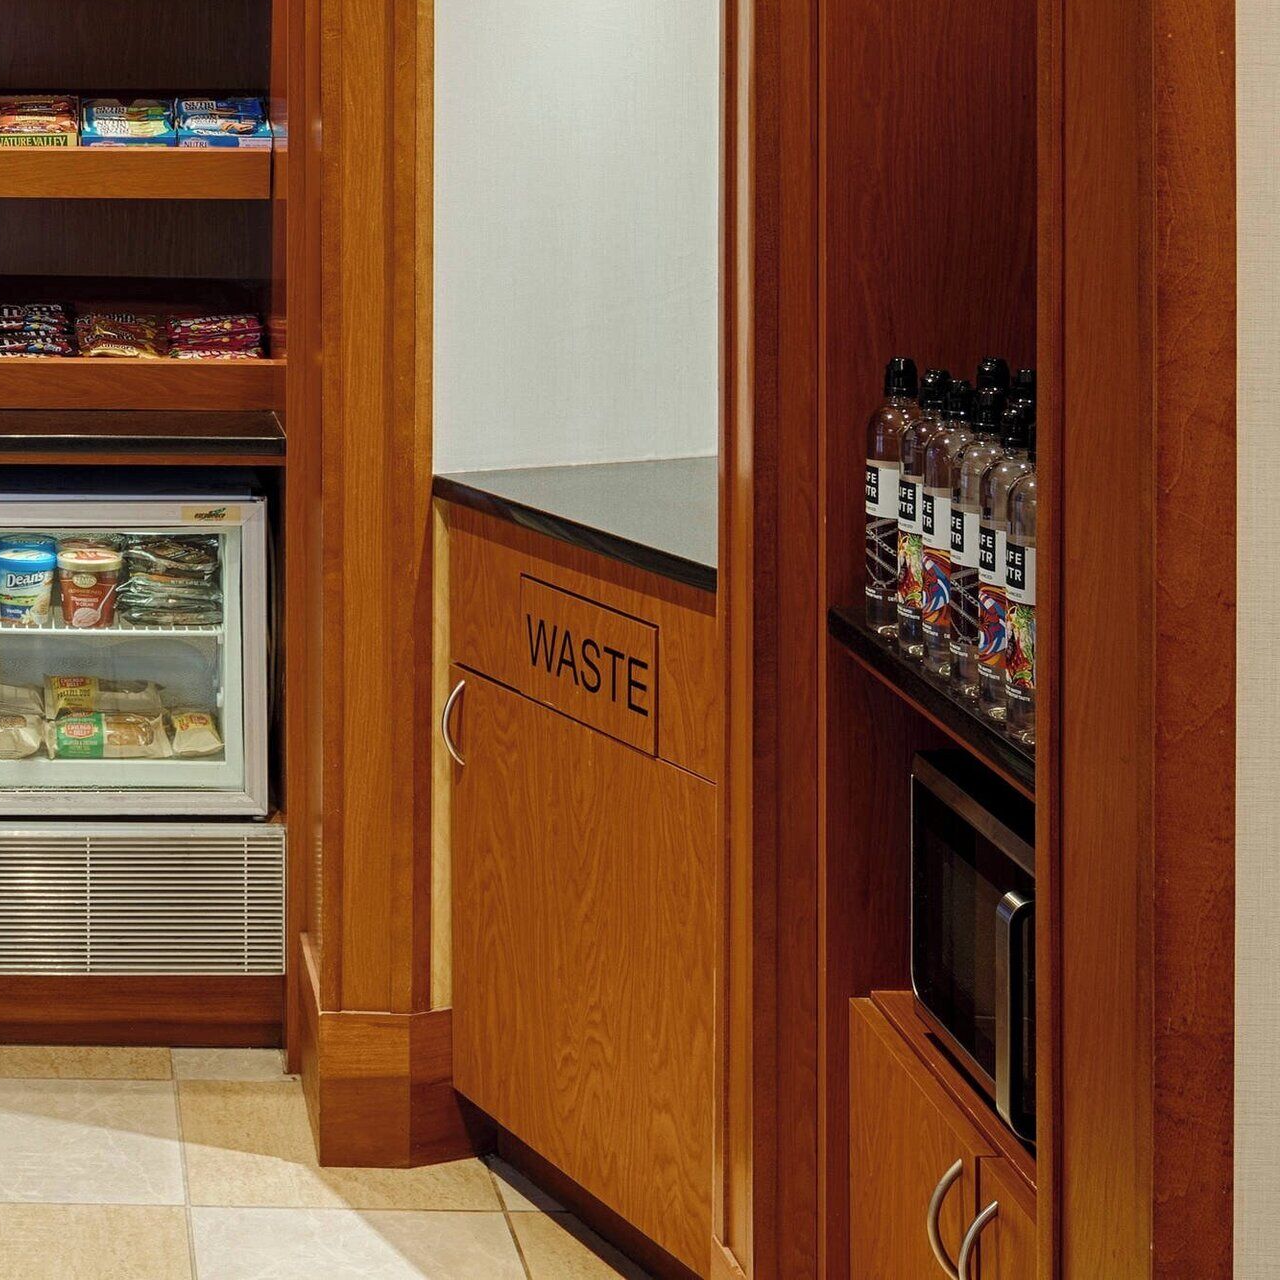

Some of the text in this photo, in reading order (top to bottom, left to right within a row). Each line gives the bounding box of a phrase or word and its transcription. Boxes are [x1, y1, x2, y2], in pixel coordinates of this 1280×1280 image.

[32, 136, 66, 147] VALLEY
[6, 570, 46, 588] Dean's
[526, 613, 649, 718] WASTE
